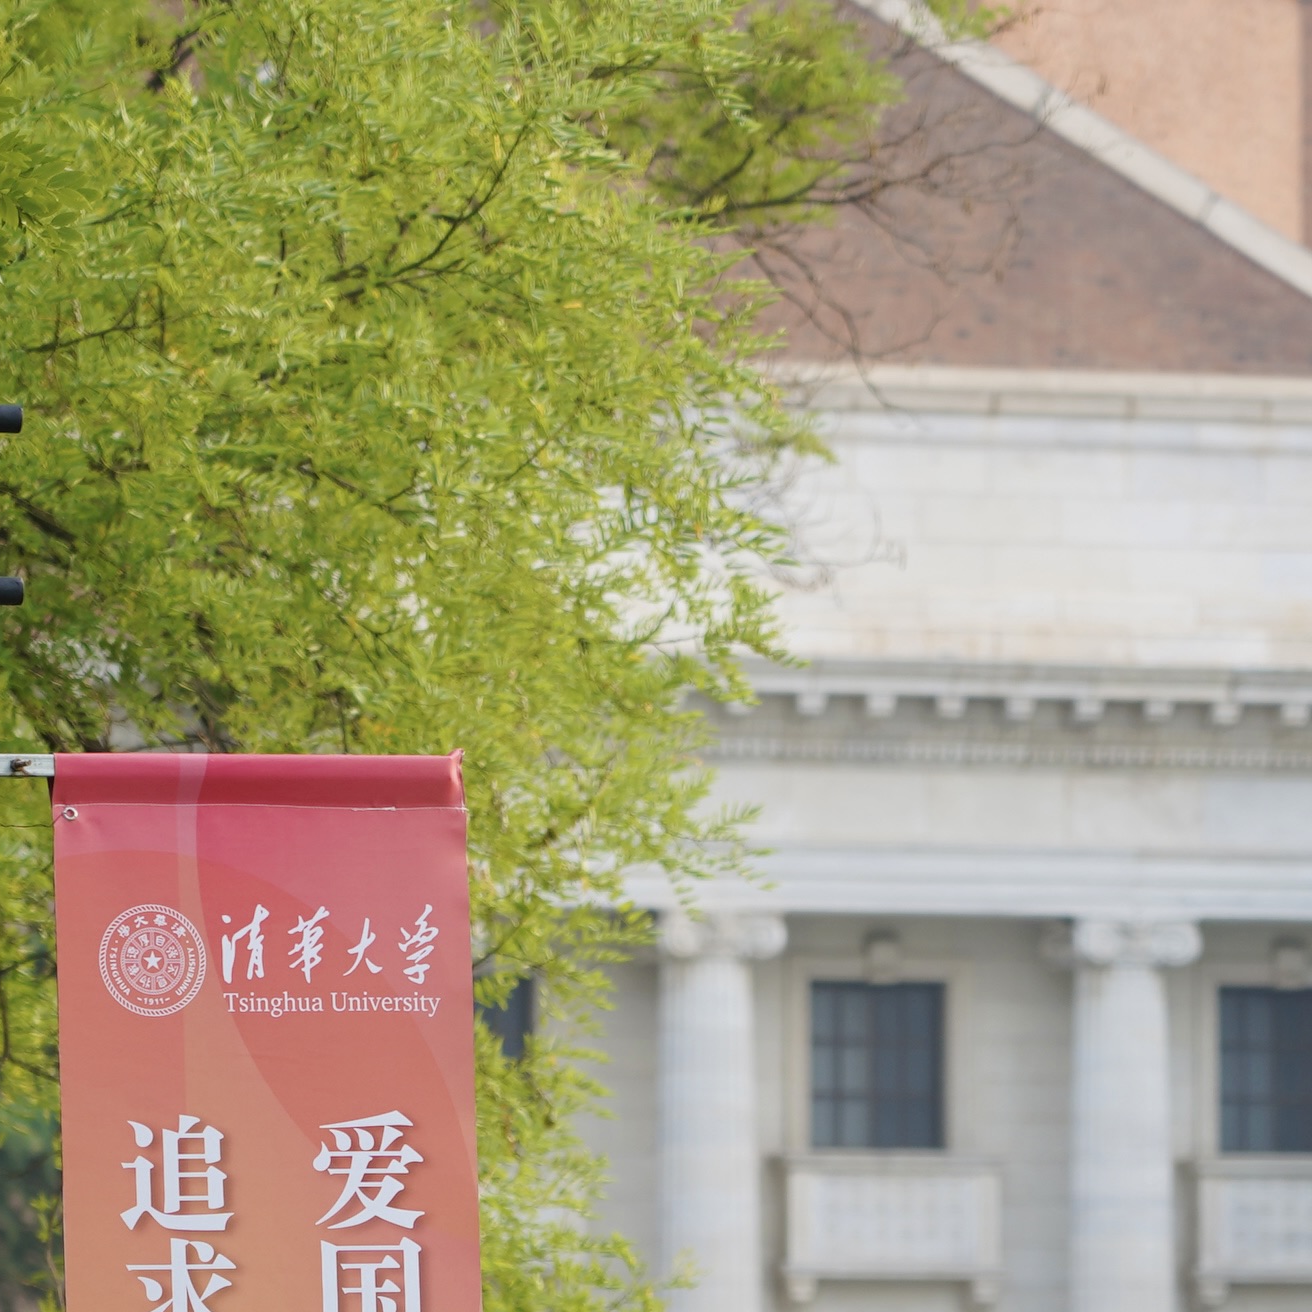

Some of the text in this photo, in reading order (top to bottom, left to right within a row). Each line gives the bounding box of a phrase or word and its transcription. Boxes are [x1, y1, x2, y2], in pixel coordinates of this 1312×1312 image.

[109, 947, 131, 996] TSINGHUA
[223, 991, 441, 1018] Tsinghua University
